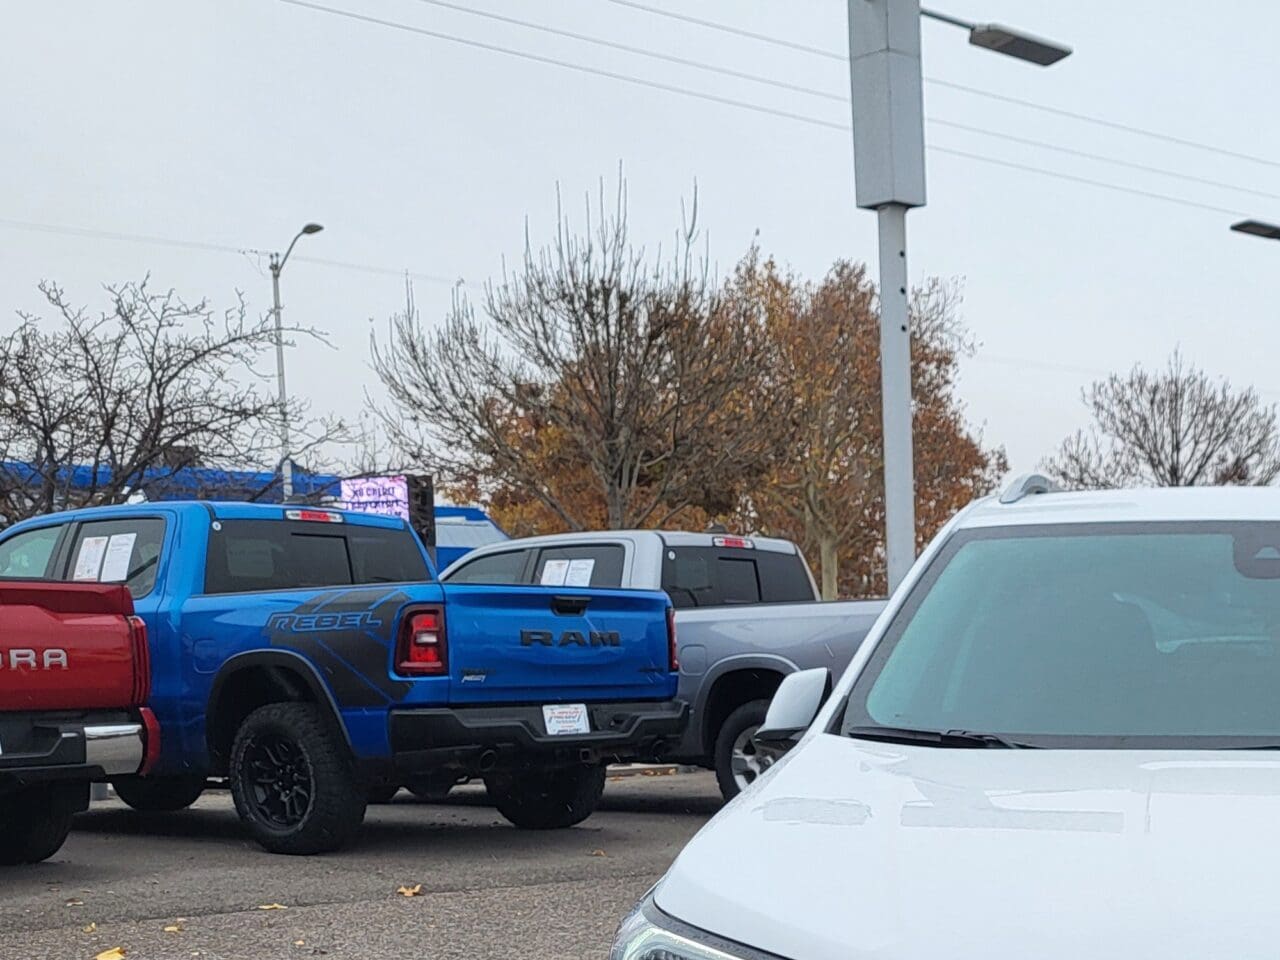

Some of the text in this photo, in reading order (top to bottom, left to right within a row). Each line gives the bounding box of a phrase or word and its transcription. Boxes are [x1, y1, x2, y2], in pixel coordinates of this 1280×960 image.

[266, 611, 382, 632] REBEL
[520, 629, 621, 648] RAM
[0, 648, 69, 671] RA
